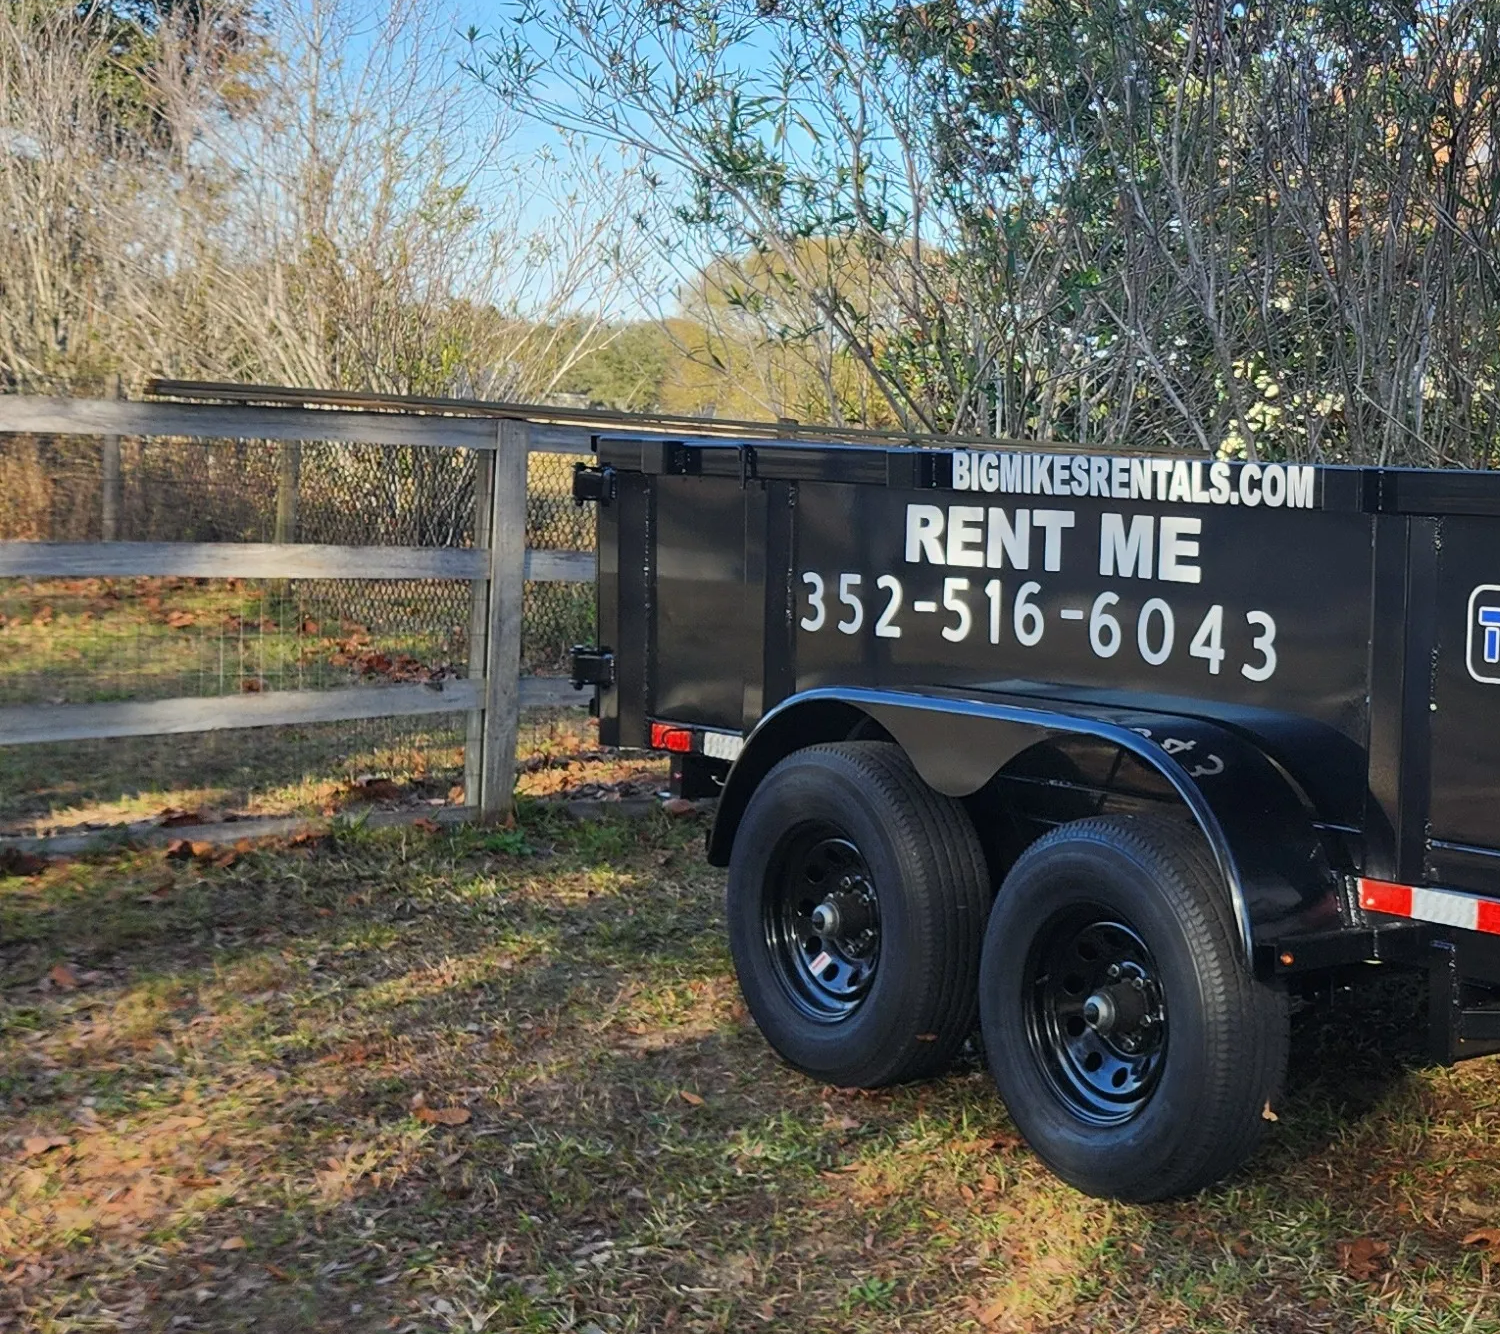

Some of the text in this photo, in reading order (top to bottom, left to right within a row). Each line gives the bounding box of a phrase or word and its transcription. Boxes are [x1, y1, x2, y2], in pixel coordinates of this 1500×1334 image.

[952, 452, 1314, 509] BIGMIKESRENTALS.COM
[905, 503, 1202, 584] RENT ME
[800, 571, 1278, 681] 352-516-6043
